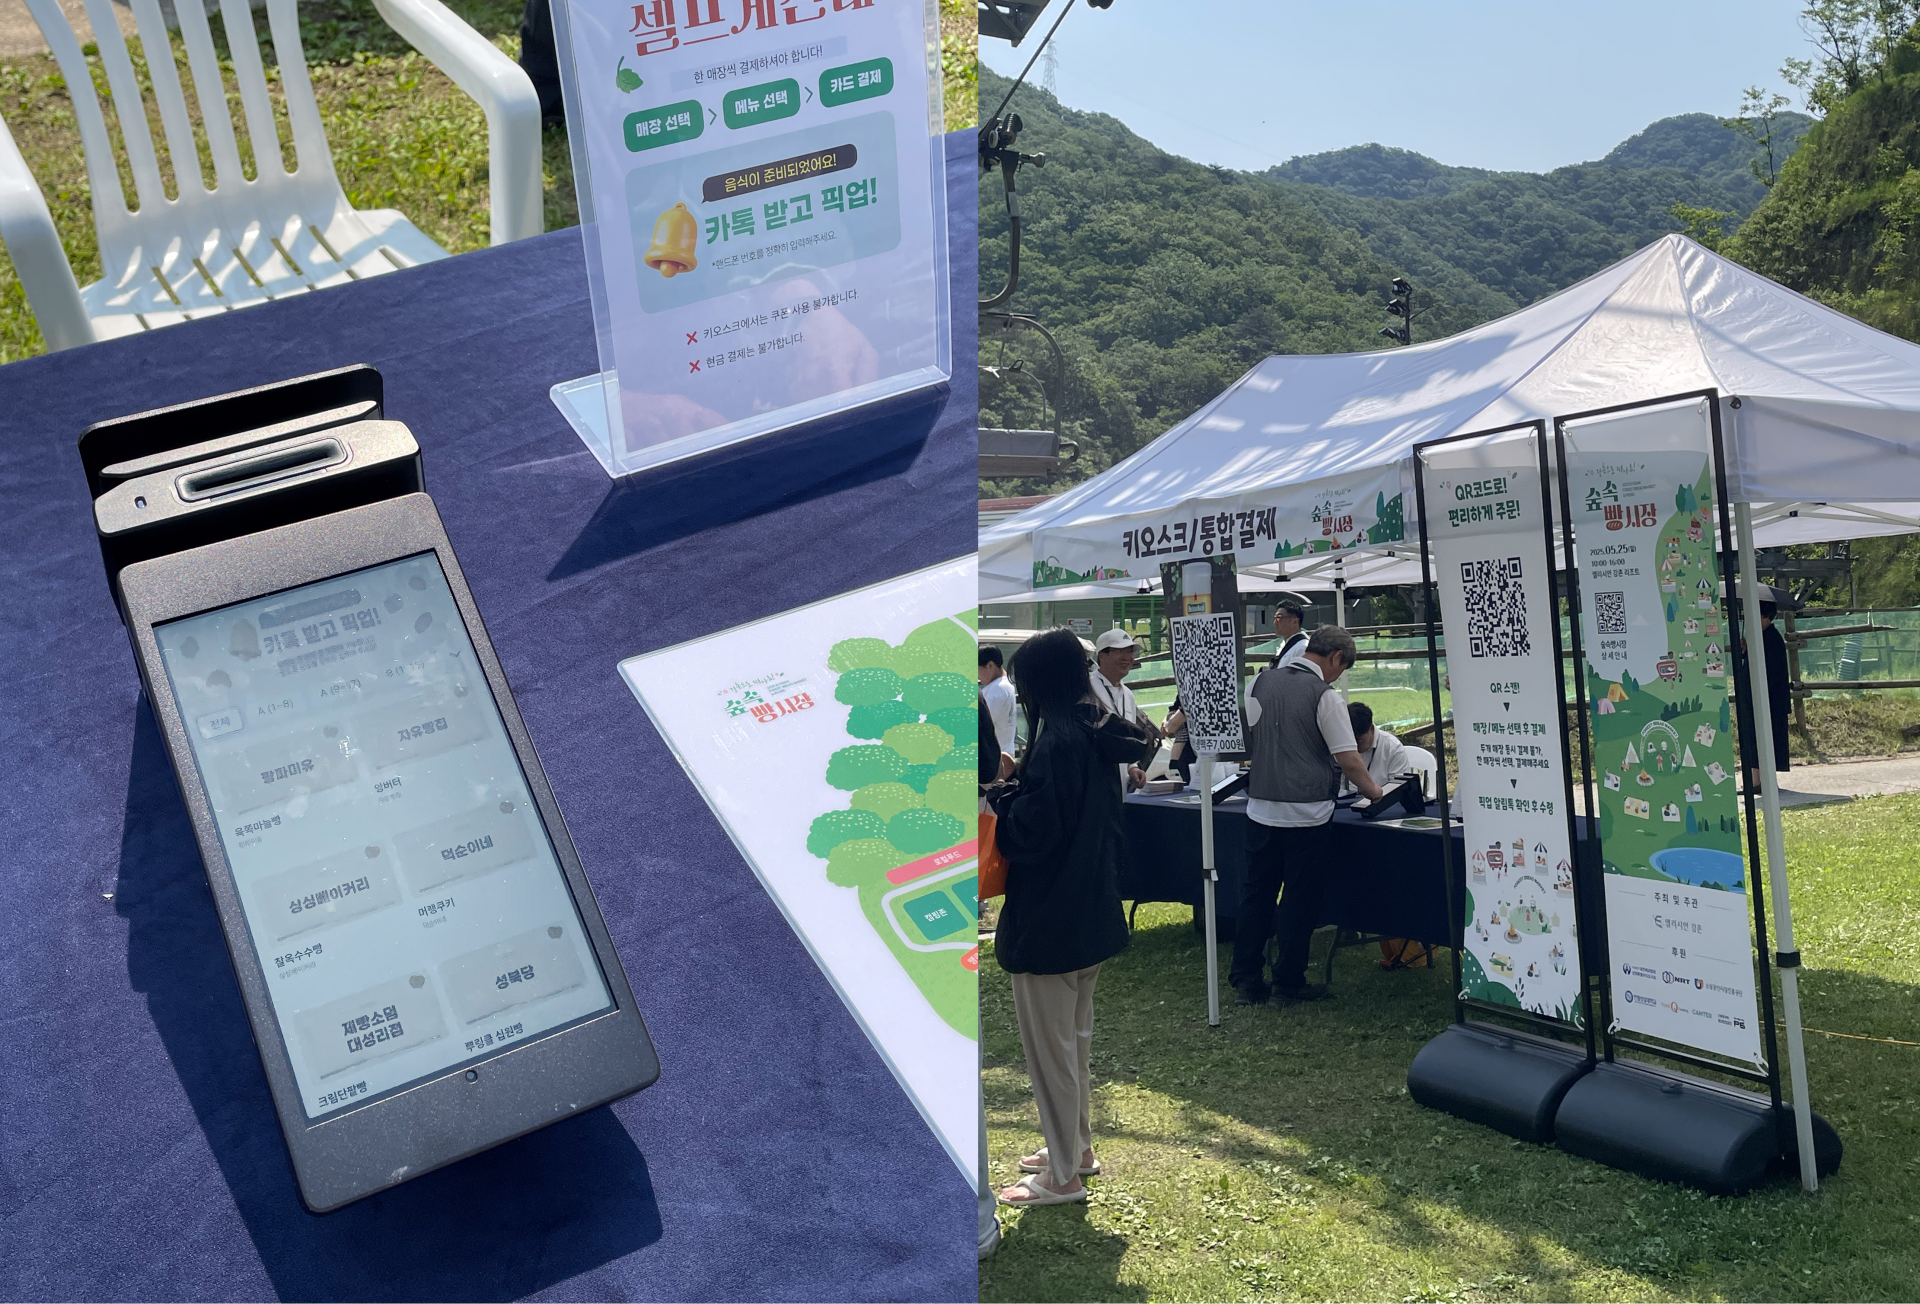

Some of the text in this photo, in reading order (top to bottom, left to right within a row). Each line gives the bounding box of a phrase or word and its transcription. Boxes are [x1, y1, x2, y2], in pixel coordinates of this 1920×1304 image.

[694, 45, 823, 84] 한 매장씩 결제하셔야 합니다!
[831, 69, 881, 93] 카드 결제
[735, 90, 788, 115] 메뉴 선택
[636, 112, 691, 138] 매장 선택
[725, 154, 836, 192] 음식이 준비되었어요!
[705, 177, 877, 244] 카톡 받고 픽업!
[741, 249, 763, 263] 번호를
[766, 242, 788, 257] 정확히
[790, 231, 837, 251] 입력해주세요.
[703, 289, 859, 339] 키오스크에서는 쿠폰 사용 불가합니다.
[706, 332, 805, 369] 현금 결제는 불가합니다.
[1455, 477, 1507, 500] QR코드로!
[1585, 481, 1618, 512] 숲속
[1311, 501, 1331, 523] 숲속
[1448, 500, 1520, 527] 편리하게 주문!
[1604, 503, 1657, 531] 빵시장
[1123, 507, 1277, 558] 키오스크/통합결제
[1322, 515, 1353, 535] 빵시장
[1490, 682, 1520, 694] QR 스캔!
[724, 691, 764, 718] 숲속
[750, 692, 814, 723] 빵시장
[1507, 723, 1521, 735] 선택
[1523, 722, 1529, 735] 후
[1531, 723, 1546, 736] 결제
[1477, 756, 1482, 766] 한
[1516, 758, 1549, 769] 결제해주세요
[1505, 745, 1516, 755] 동시
[1517, 745, 1528, 755] 결제
[1479, 796, 1553, 815] 픽업 알림톡 확인 후 수령
[235, 815, 281, 837] 육쪽마늘빵
[418, 897, 455, 918] 머랭쿠키
[924, 908, 948, 922] 캠핑존
[274, 943, 323, 968] 찰옥수수빵
[1672, 947, 1686, 959] 후원
[347, 1022, 404, 1053] 대성리점
[495, 1022, 524, 1042] 십원빵
[318, 1081, 367, 1108] 크림단팥빵
